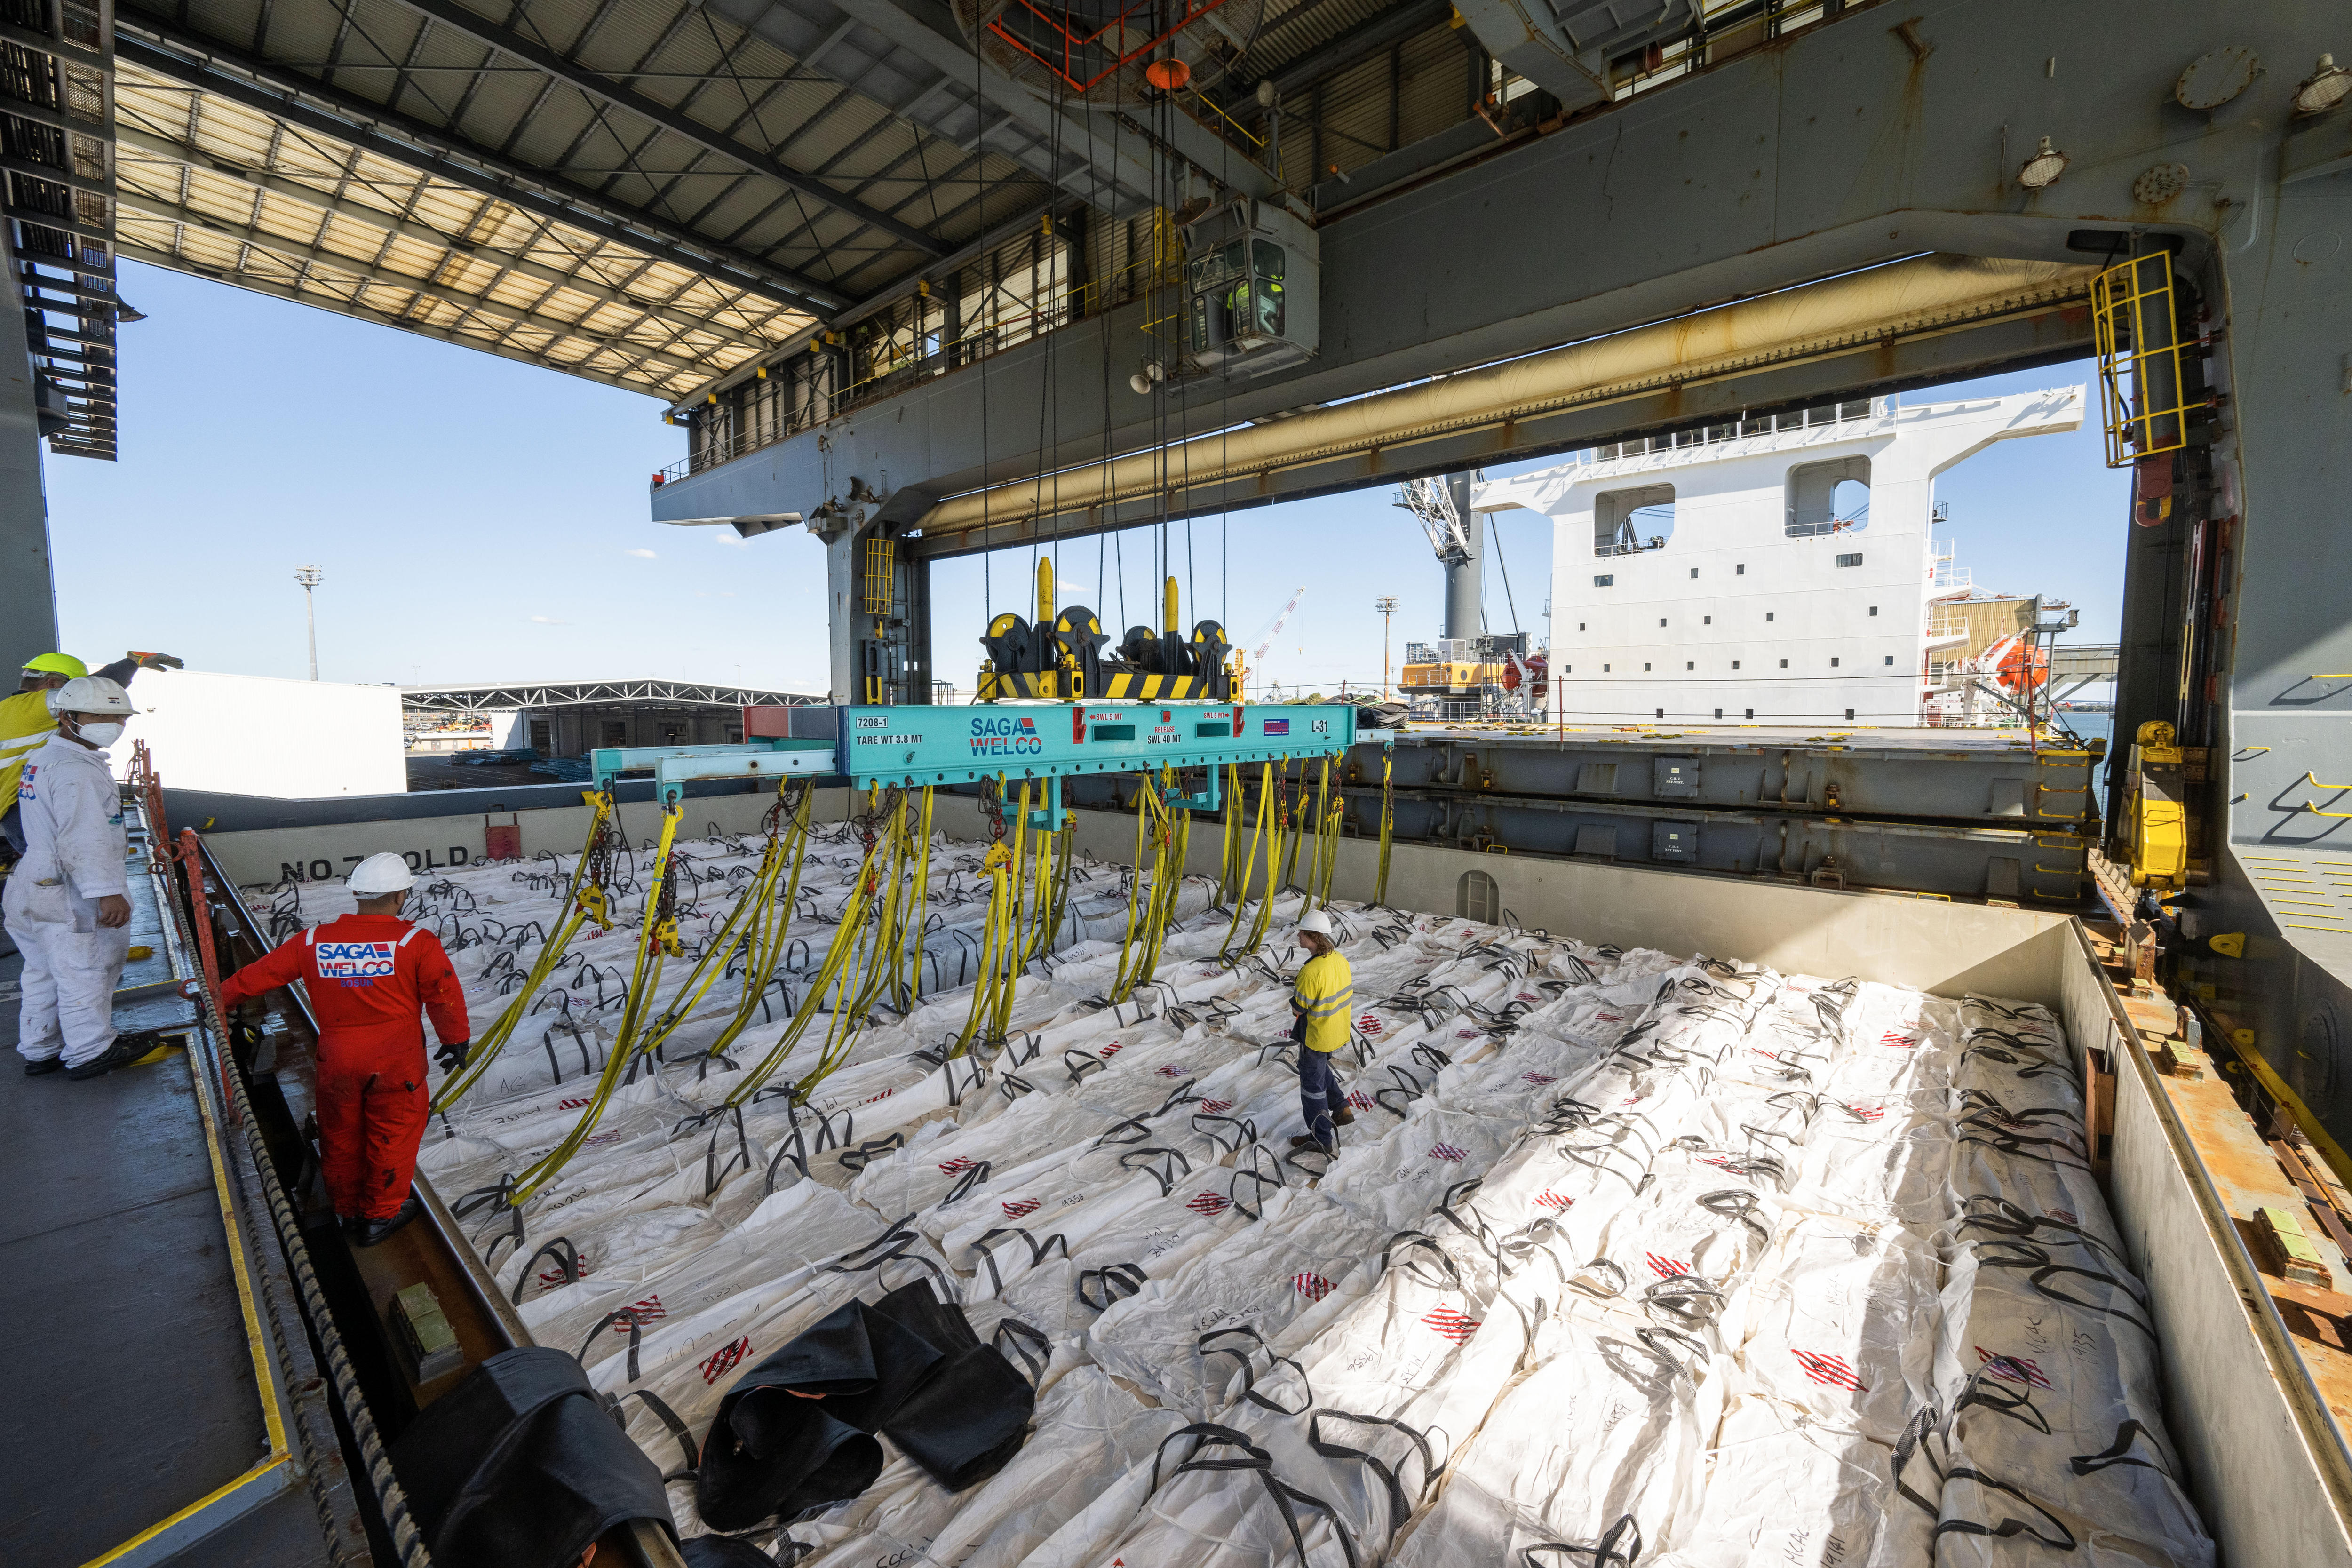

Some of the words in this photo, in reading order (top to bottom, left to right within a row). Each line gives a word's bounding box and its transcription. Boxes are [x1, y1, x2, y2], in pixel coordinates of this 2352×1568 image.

[857, 718, 887, 727] 7208-1
[970, 717, 1026, 737] SAGA
[1311, 720, 1328, 733] L-31
[857, 736, 878, 745] TARE
[880, 735, 893, 744] WT
[896, 735, 908, 744] 3.8
[911, 734, 923, 743] MT
[1148, 735, 1161, 744] SWL
[1162, 735, 1170, 744] 40
[1172, 734, 1181, 743] MT
[970, 737, 1042, 756] WELCO
[402, 846, 468, 871] OLD
[318, 944, 377, 960] SAGA
[319, 960, 394, 977] WELCO
[341, 979, 373, 987] BOSUN
[500, 1076, 526, 1095] AG
[1436, 1317, 1446, 1330] SOLID
[1441, 1311, 1455, 1337] FLAMMABLE
[705, 1356, 739, 1368] FLAMMAB
[1824, 1362, 1844, 1384] FLAMMABLE
[1835, 1371, 1848, 1384] SOLID
